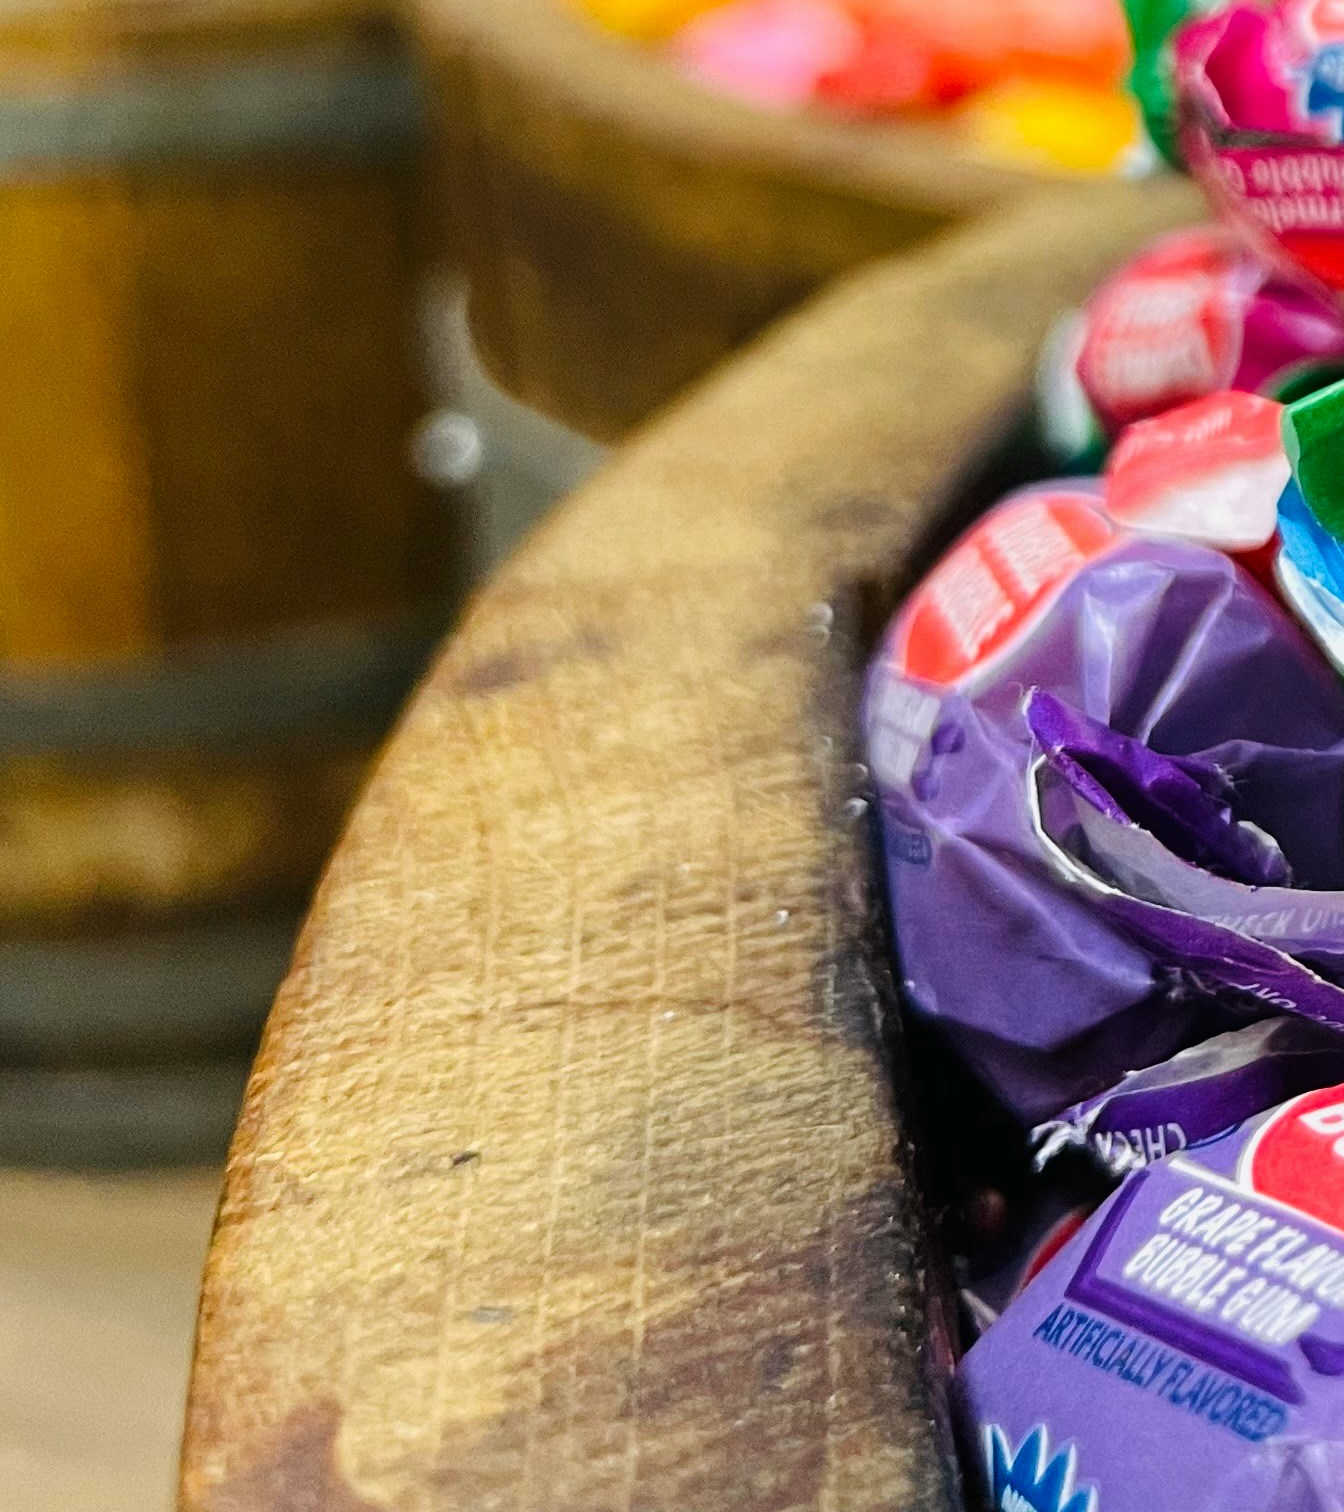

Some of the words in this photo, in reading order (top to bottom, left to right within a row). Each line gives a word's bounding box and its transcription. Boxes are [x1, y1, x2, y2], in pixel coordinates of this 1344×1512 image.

[1158, 1187, 1277, 1255] GRAPE
[1121, 1232, 1247, 1314] BUBBLE
[1220, 1276, 1322, 1347] GUM
[1031, 1303, 1171, 1392] ARTIFICIALLY
[1161, 1353, 1290, 1444] FLAVORED
